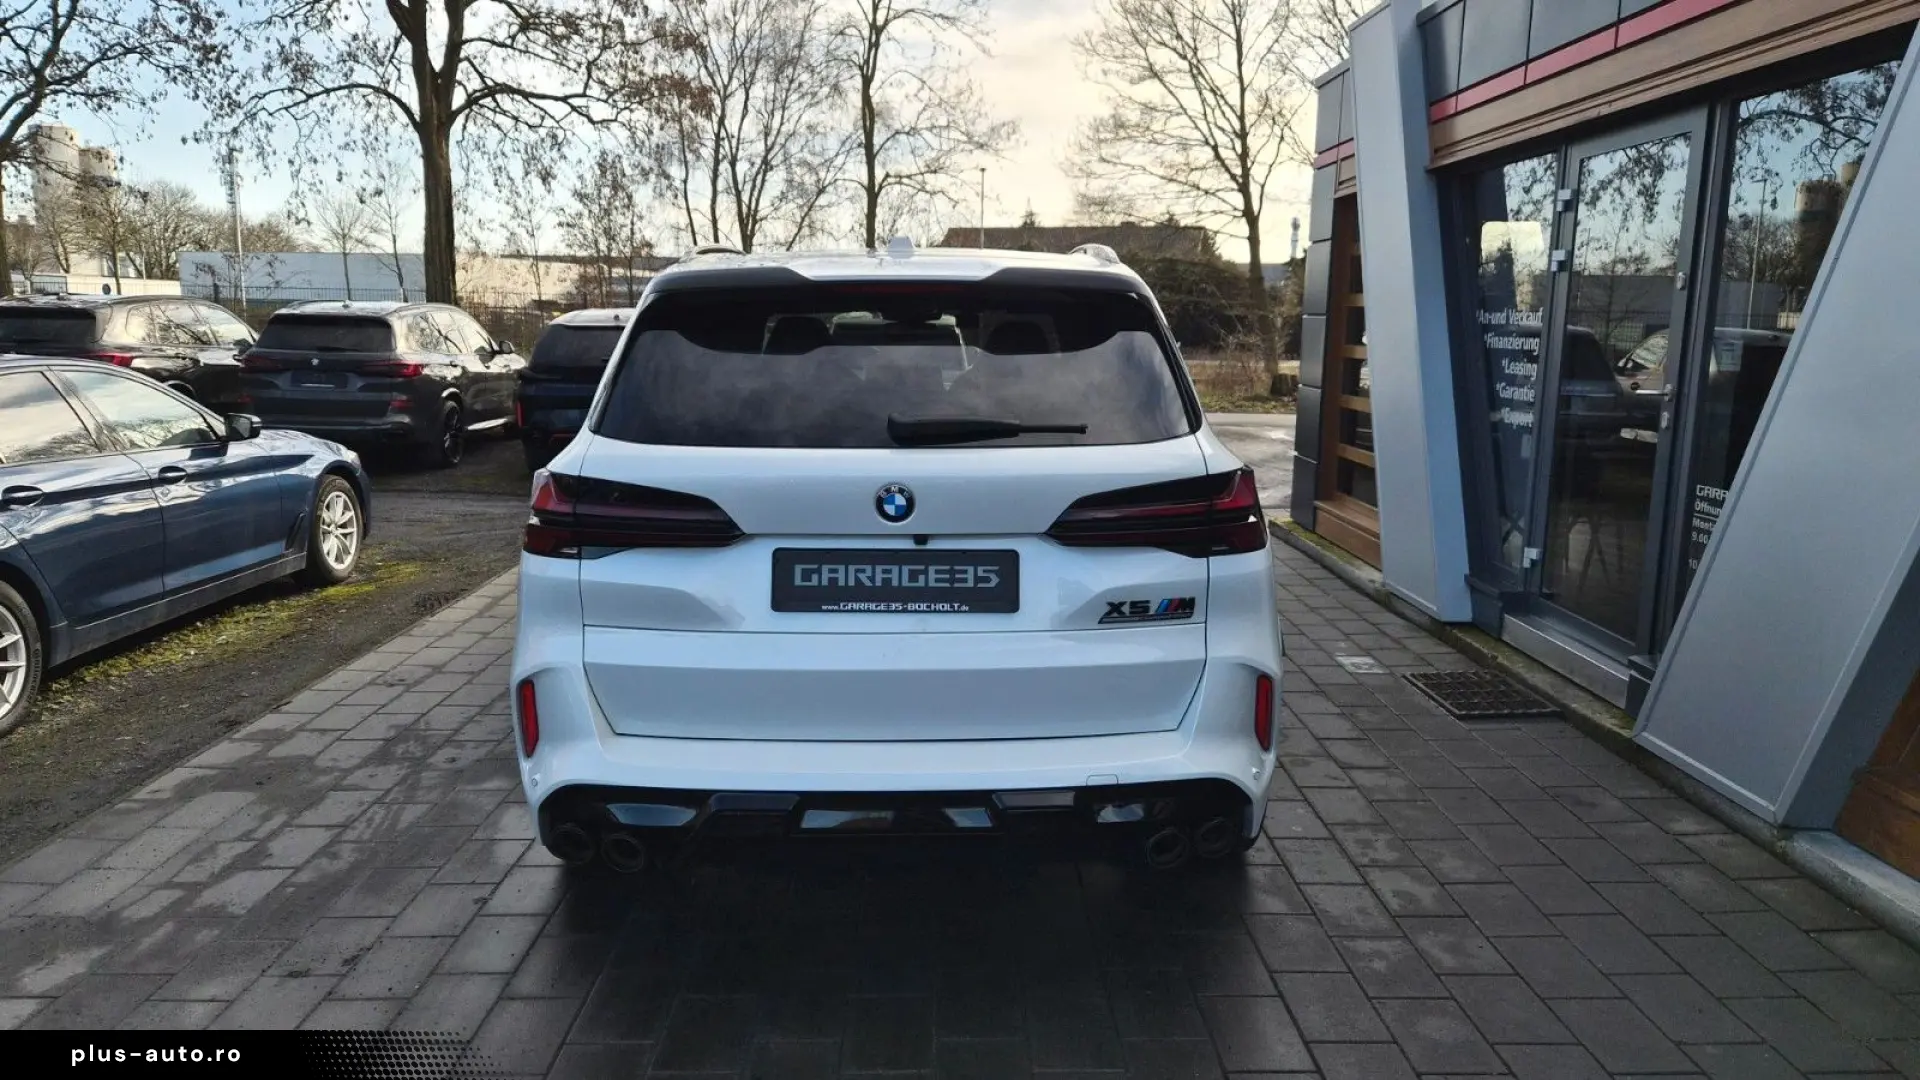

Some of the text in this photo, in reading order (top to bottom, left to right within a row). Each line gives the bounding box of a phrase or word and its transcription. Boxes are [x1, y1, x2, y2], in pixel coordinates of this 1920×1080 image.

[794, 564, 1000, 588] GARAGE35
[821, 602, 969, 612] www.GARAGE35-BOCHOLT.de
[1105, 600, 1151, 617] X5
